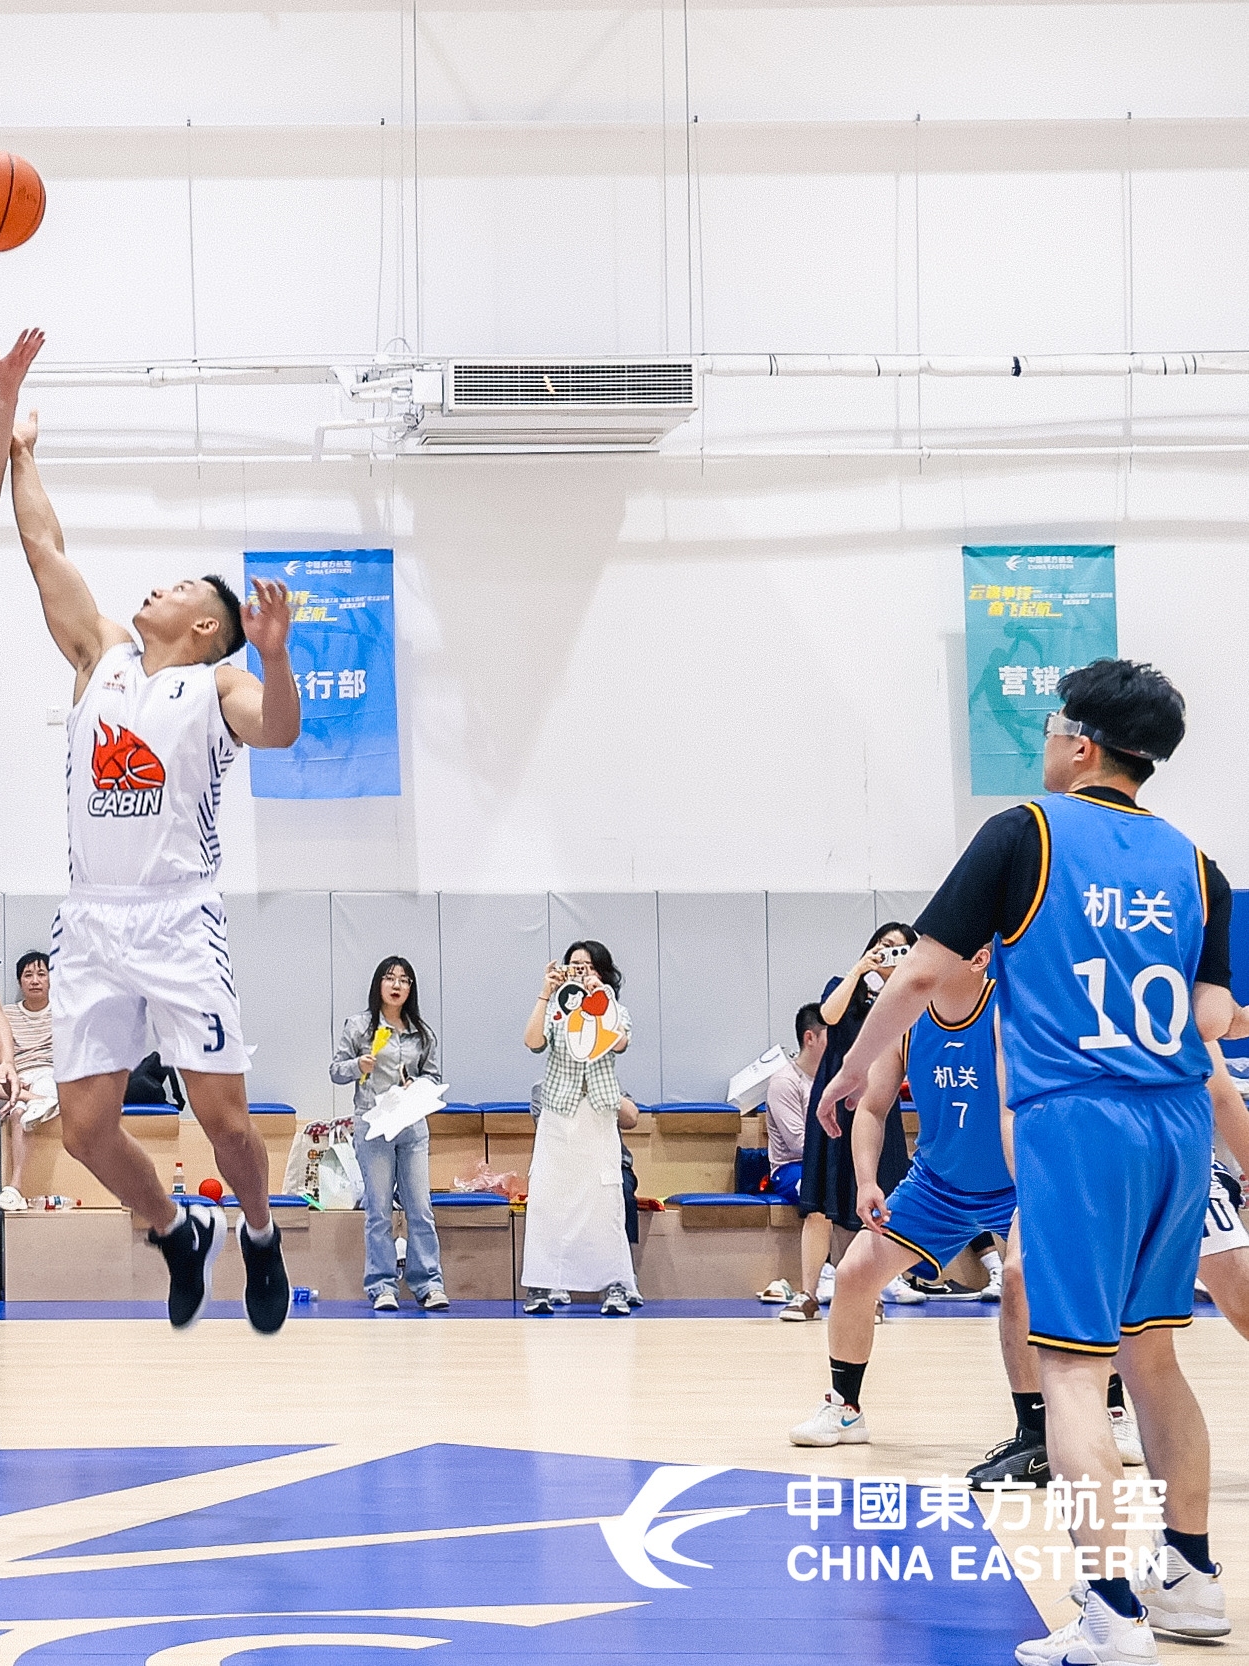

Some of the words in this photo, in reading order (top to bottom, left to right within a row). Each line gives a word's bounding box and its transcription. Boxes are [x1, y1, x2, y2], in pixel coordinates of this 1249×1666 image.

[998, 665, 1088, 696] 营销
[88, 788, 163, 817] CABIN
[1083, 883, 1174, 935] 机关
[1072, 957, 1190, 1057] 10
[202, 1012, 225, 1053] 3
[933, 1065, 980, 1090] 机关
[951, 1101, 969, 1129] 7
